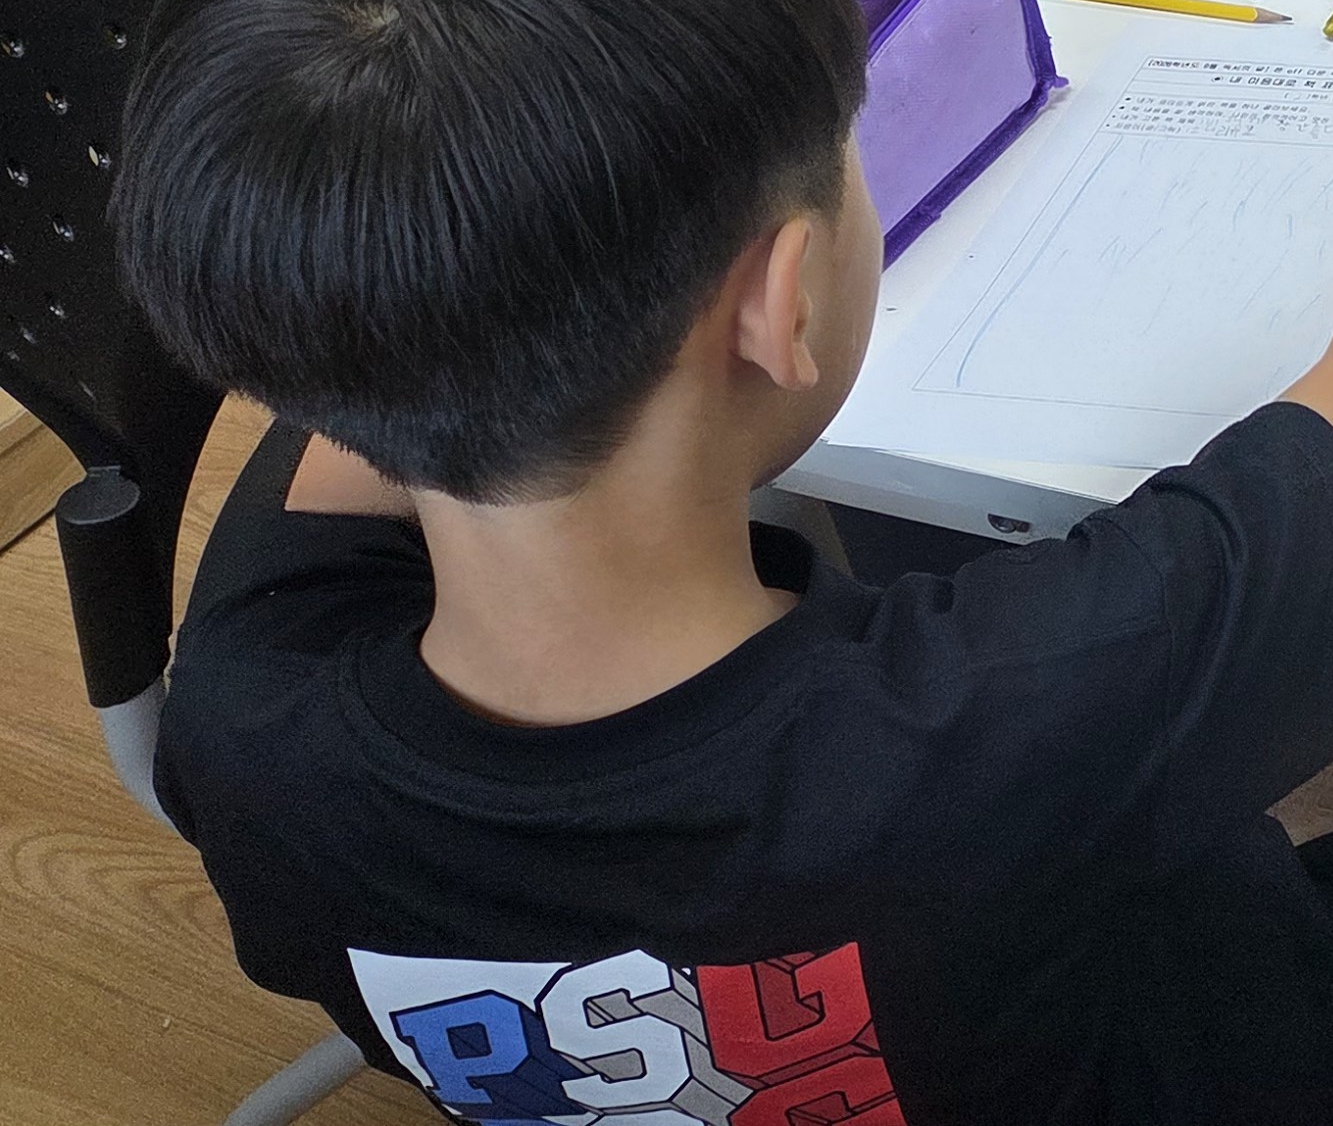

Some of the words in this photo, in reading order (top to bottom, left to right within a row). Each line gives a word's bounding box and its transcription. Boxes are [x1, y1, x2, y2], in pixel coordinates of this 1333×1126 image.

[1228, 75, 1243, 84] 내
[1247, 76, 1297, 88] 마음대로
[1303, 79, 1316, 89] 책
